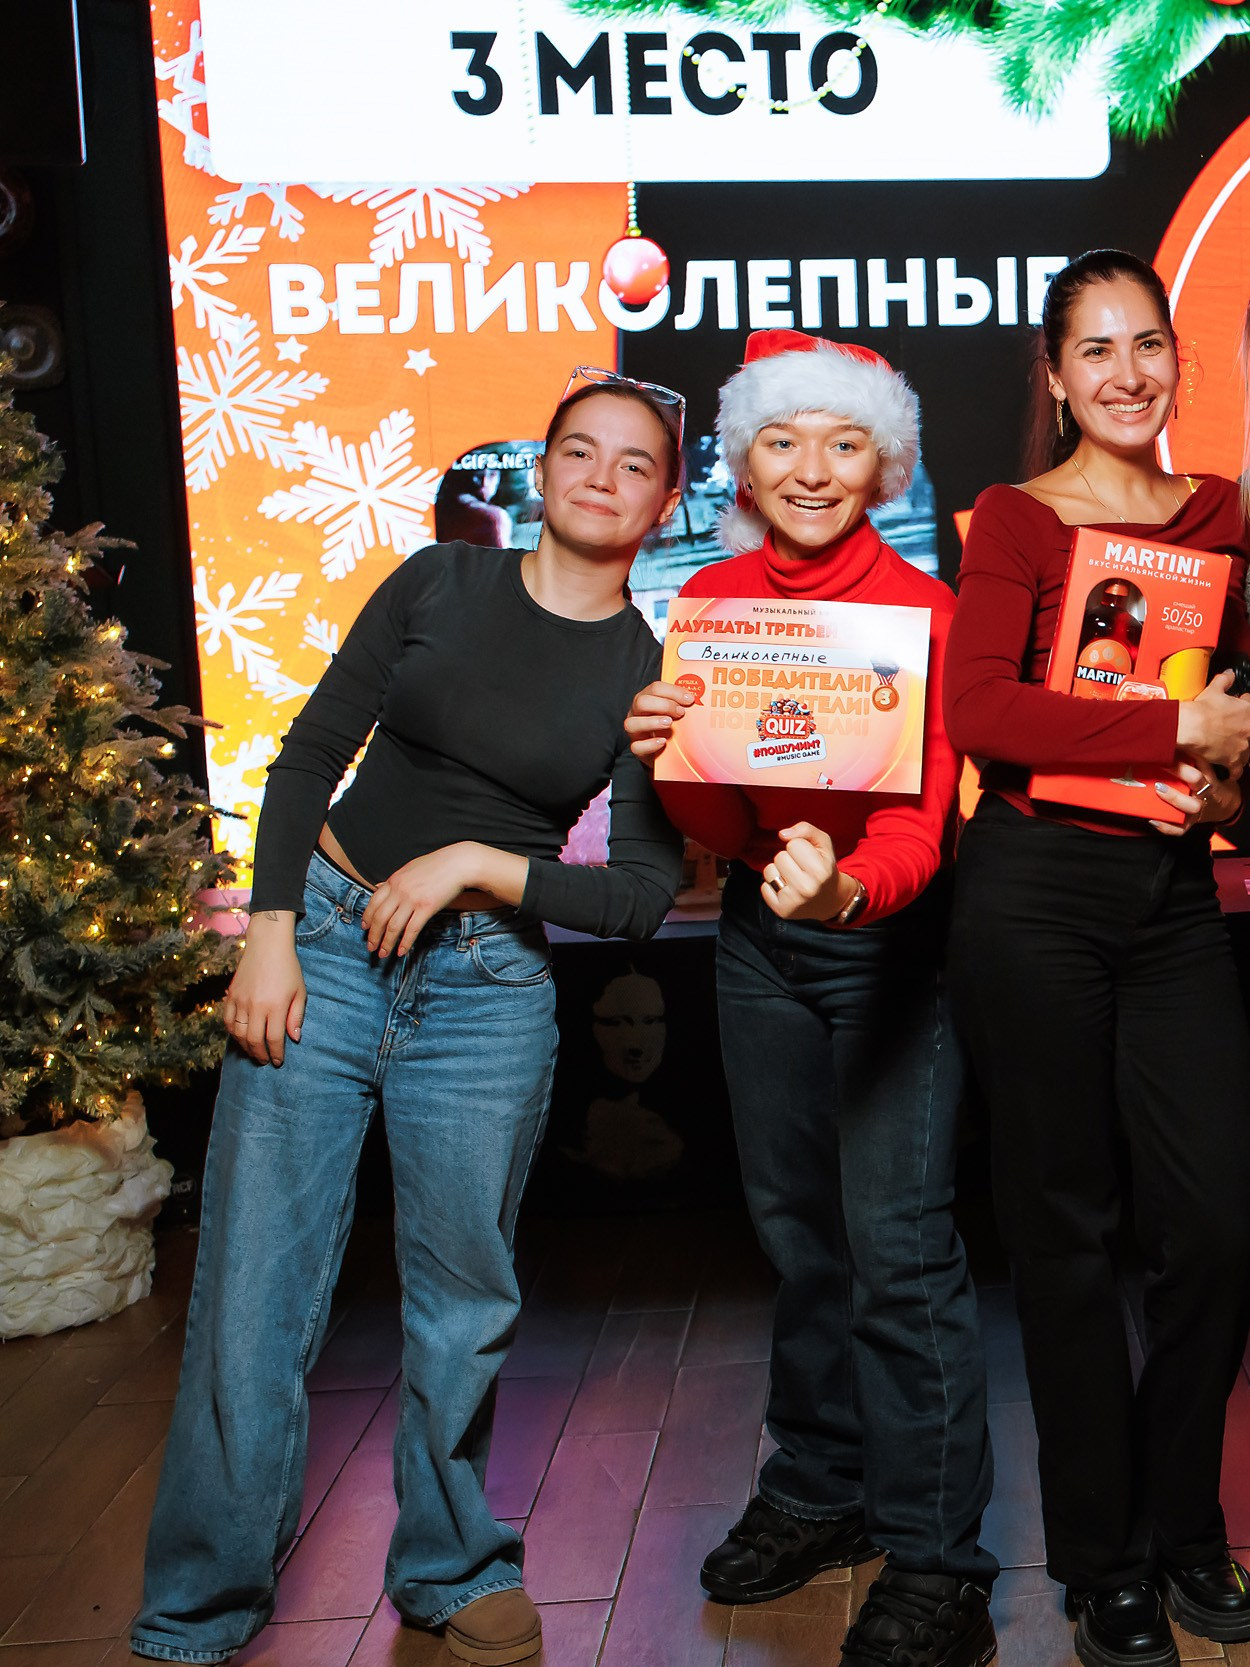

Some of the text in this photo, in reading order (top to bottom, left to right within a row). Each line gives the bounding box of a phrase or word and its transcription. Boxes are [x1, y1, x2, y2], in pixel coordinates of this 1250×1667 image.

[452, 31, 879, 117] 3 МЕСТО
[1088, 558, 1212, 588] ВКУС ИТАЛЬЯНСКОЙ ЖИЗНИ
[752, 606, 816, 616] МУЗЫКАЛЬНЫЙ
[1161, 606, 1203, 628] 50/50
[669, 619, 761, 635] ЛАУРЕАТЫ
[701, 645, 828, 665] Великолепные
[712, 667, 872, 692] ПОБЕДИТЕЛИ!
[1076, 666, 1127, 686] MARTIN
[880, 690, 891, 705] 3
[765, 719, 807, 736] QUIZ
[776, 749, 820, 761] #MUSIC GAME
